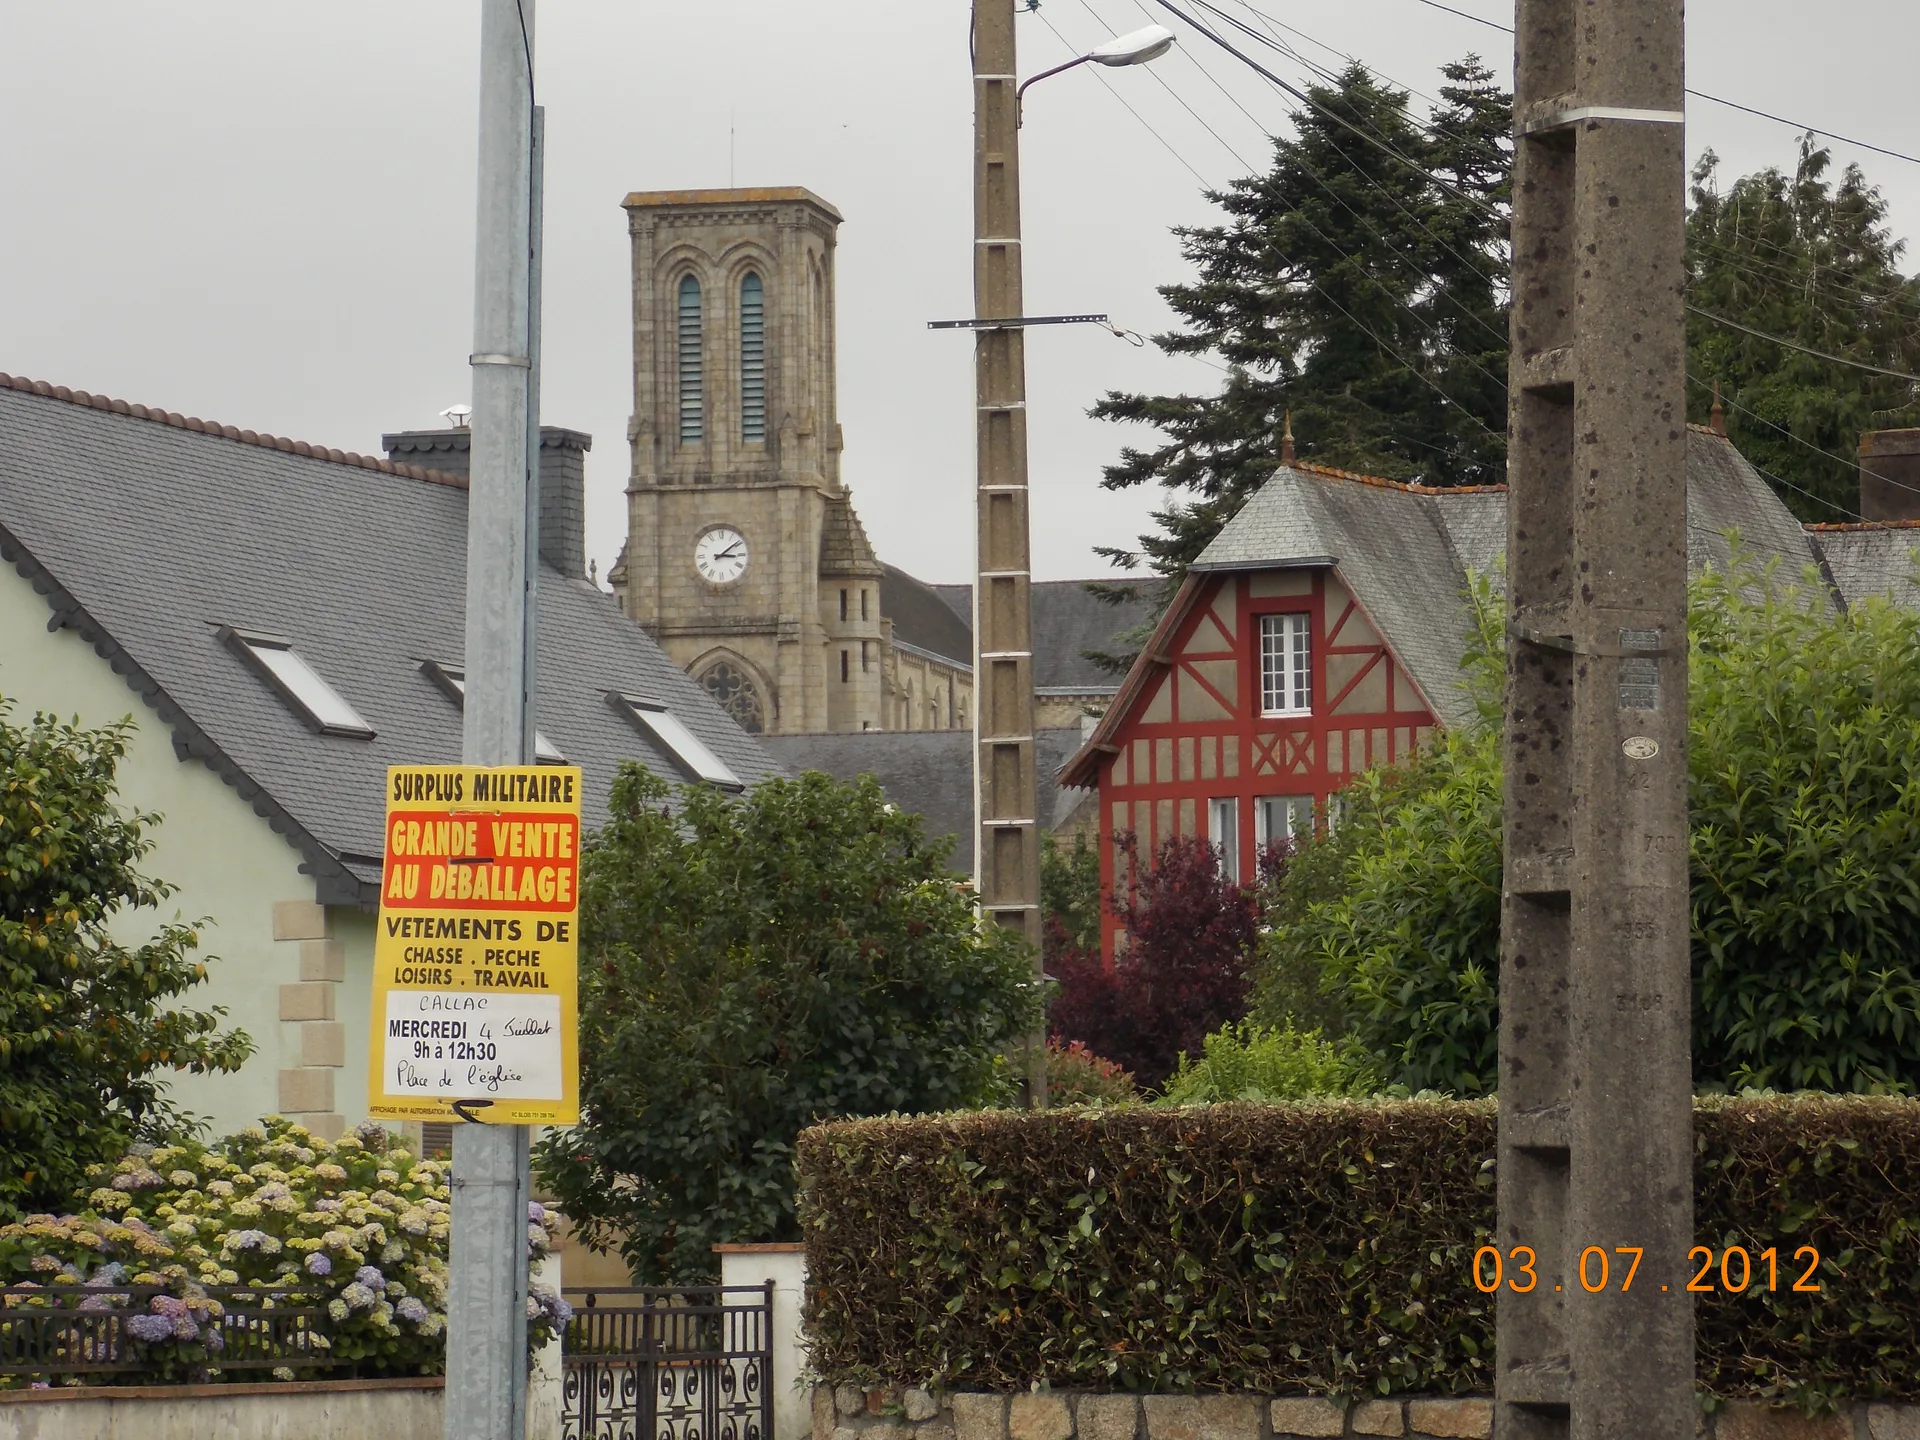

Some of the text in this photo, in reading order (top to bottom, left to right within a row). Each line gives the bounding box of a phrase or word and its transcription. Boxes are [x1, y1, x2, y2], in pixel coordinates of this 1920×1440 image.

[393, 773, 573, 803] SURPLUS MILITAIRE
[392, 820, 572, 858] GRANDE VENTE
[387, 865, 571, 903] AU DEBALLAGE
[386, 917, 570, 943] VETEMENTS DE
[404, 947, 462, 965] CHASSE
[485, 949, 540, 967] PECHE
[395, 968, 452, 985] LOISIRS
[474, 970, 548, 988] TRAVAIL
[420, 995, 488, 1011] CALLAC
[389, 1020, 467, 1039] MERCREDI
[479, 1023, 493, 1040] 4
[414, 1041, 497, 1061] 9h à 12h30
[397, 1060, 428, 1087] Place
[439, 1069, 452, 1087] de
[369, 1105, 397, 1114] AFFICHAGE
[409, 1107, 446, 1116] AUTORISATION
